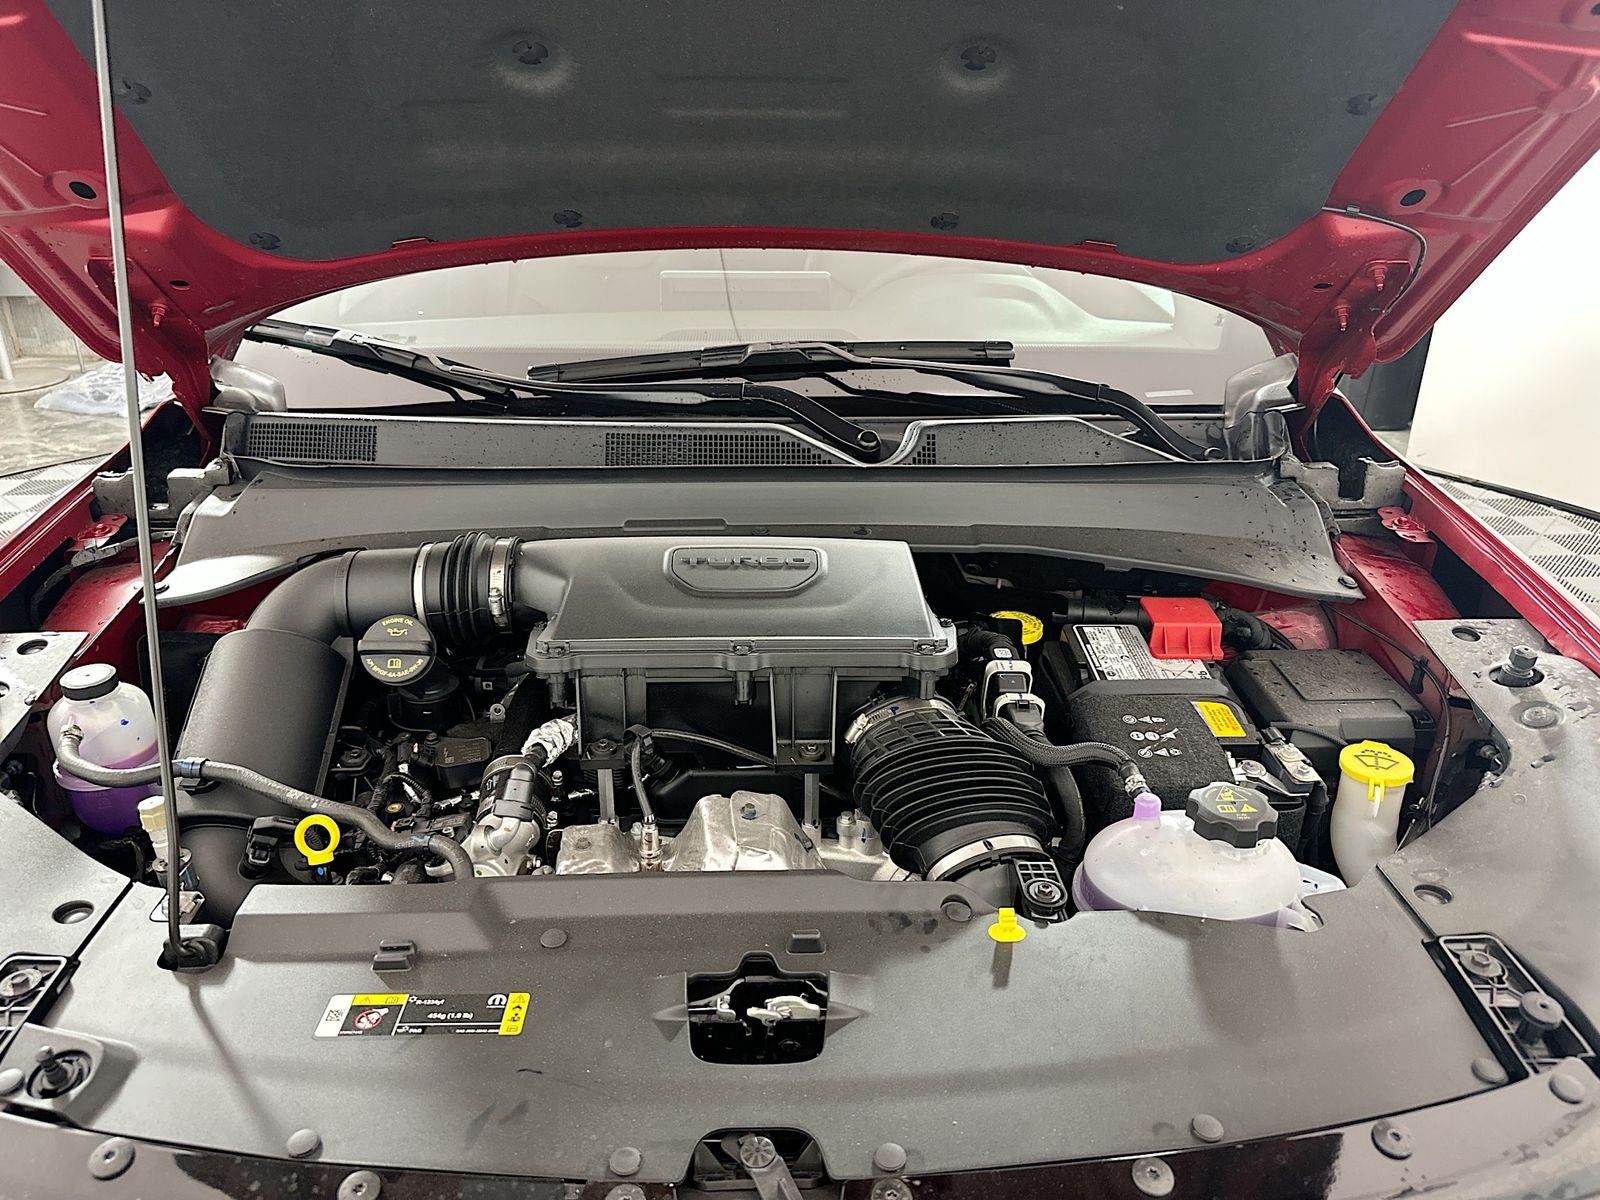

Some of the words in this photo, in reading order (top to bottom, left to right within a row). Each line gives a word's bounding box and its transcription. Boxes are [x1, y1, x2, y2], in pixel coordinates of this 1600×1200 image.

[680, 556, 811, 571] TURBO
[381, 617, 404, 627] ENGINE
[404, 619, 414, 627] OIL
